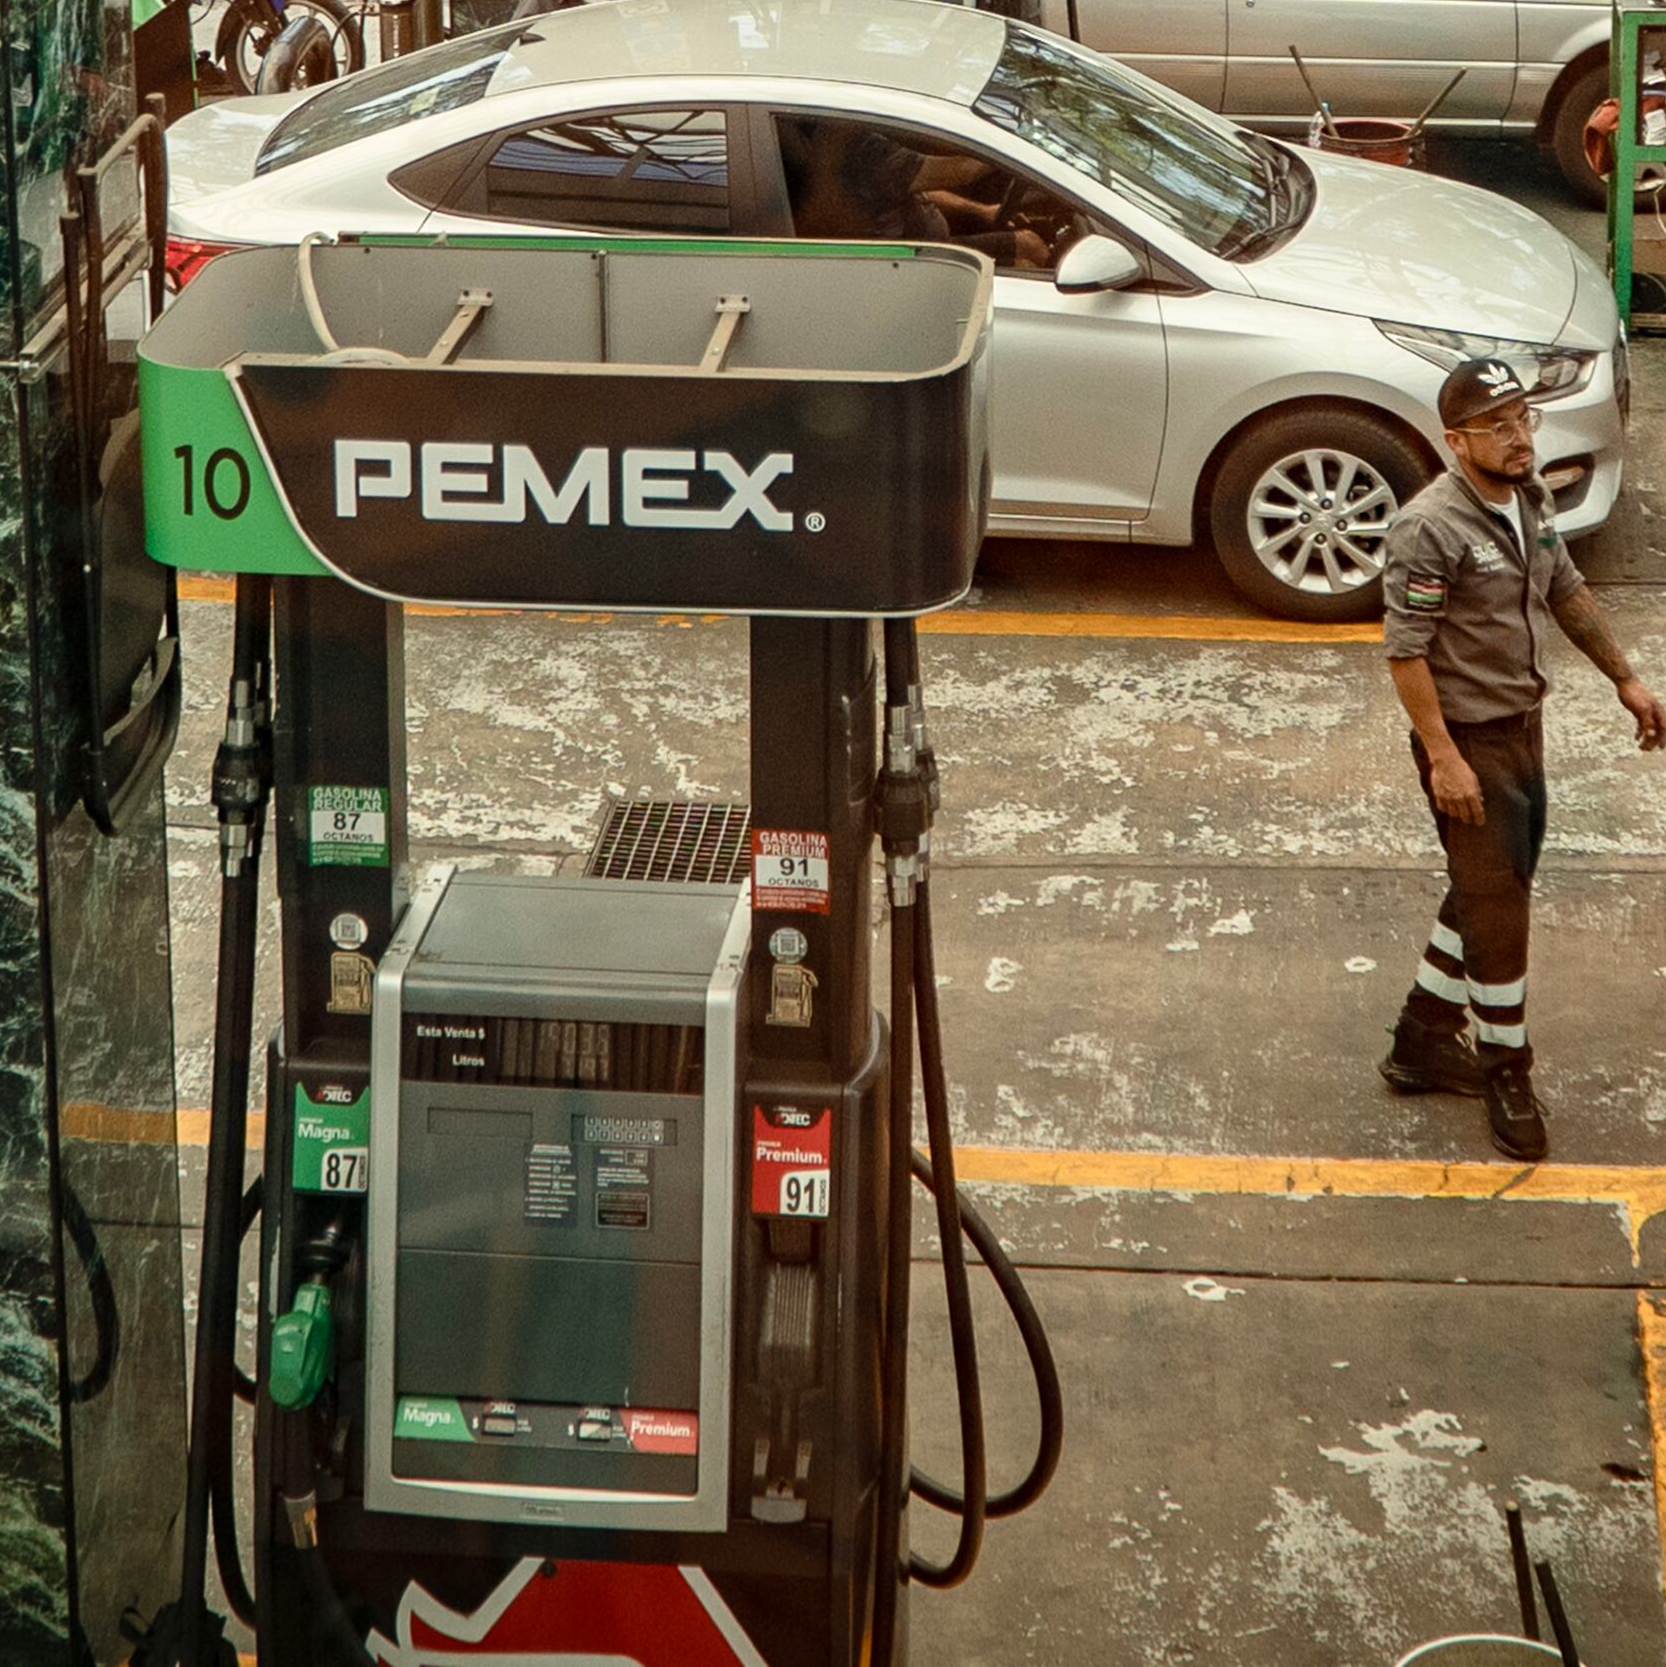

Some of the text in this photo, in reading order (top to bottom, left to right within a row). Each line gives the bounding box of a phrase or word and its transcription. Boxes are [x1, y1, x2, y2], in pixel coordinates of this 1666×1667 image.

[175, 445, 251, 521] 10
[335, 439, 794, 532] PEMEX
[313, 786, 383, 801] GASOLINA
[313, 797, 383, 813] REGULAR
[333, 812, 362, 831] 87
[759, 831, 828, 848] GASOLINA
[762, 843, 826, 859] PREMIUM
[779, 857, 809, 877] 91
[768, 877, 820, 888] OCTANOS
[416, 1024, 442, 1037] Esta
[445, 1024, 476, 1039] Venta
[452, 1053, 485, 1067] Litros
[298, 1123, 350, 1143] Magna
[756, 1147, 823, 1165] Premium
[326, 1153, 357, 1188] 87
[786, 1176, 816, 1213] 91
[403, 1406, 451, 1427] Magna
[472, 1417, 479, 1429] $
[568, 1423, 574, 1436] $
[631, 1420, 691, 1438] Premium
